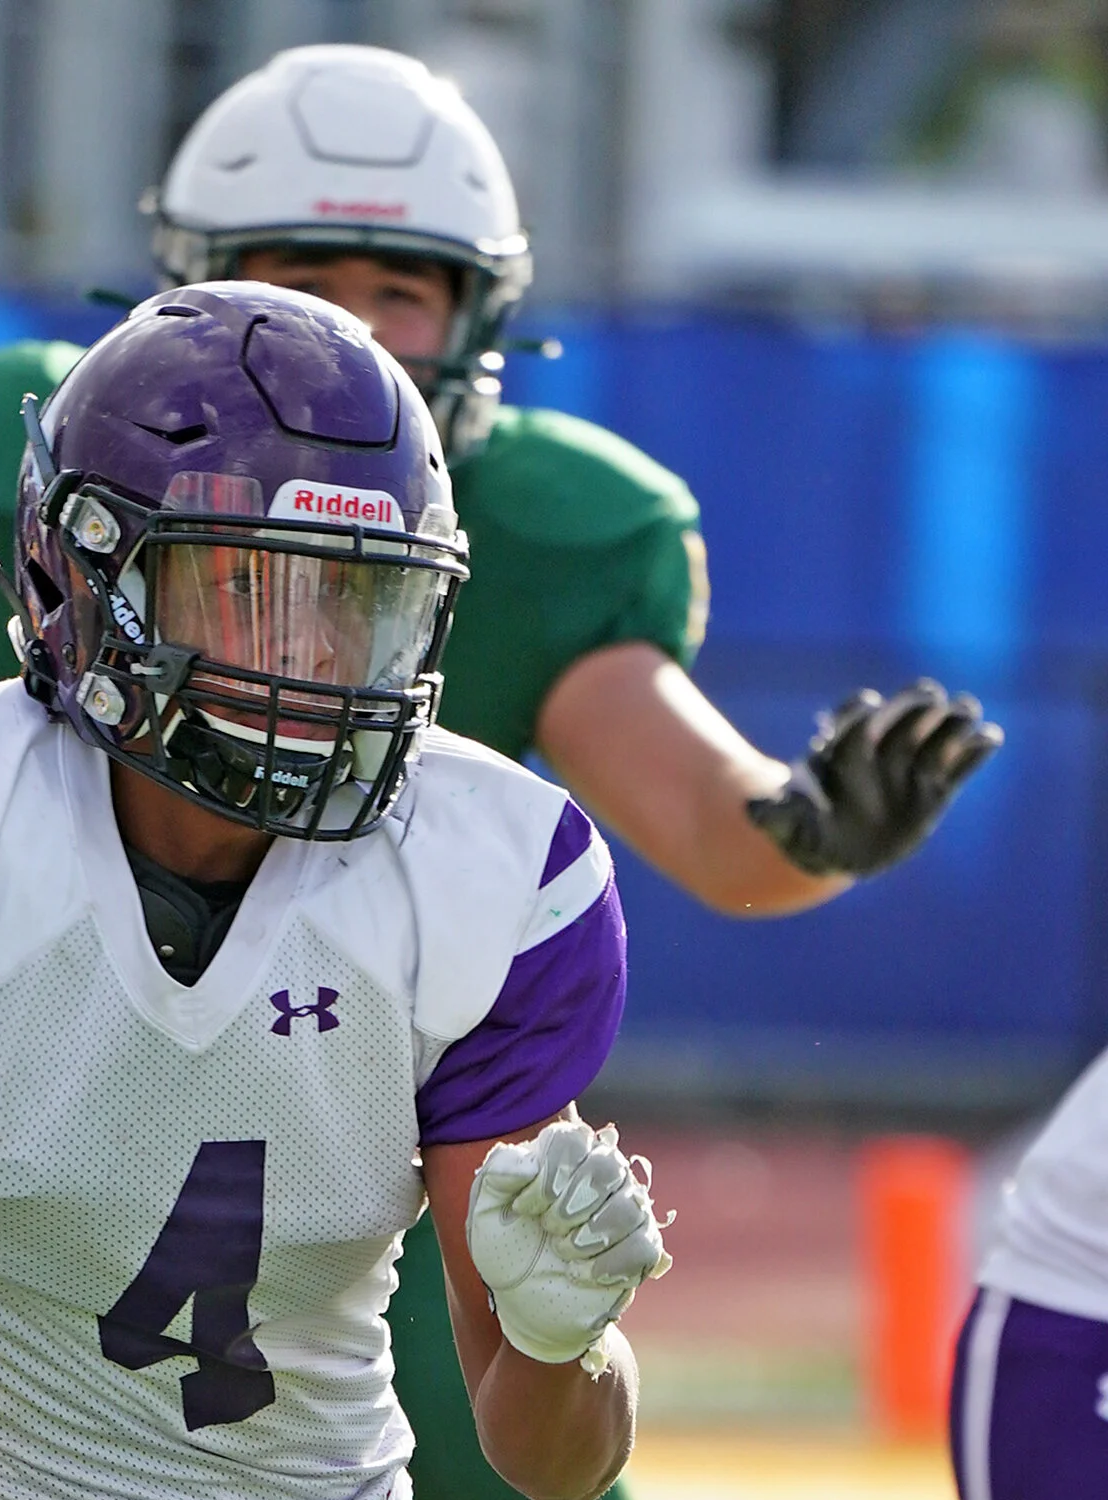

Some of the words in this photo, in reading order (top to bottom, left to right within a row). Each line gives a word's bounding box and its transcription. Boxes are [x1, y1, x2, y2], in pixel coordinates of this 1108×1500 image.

[293, 489, 392, 523] Riddell
[253, 766, 309, 789] Rddell
[96, 1139, 276, 1432] 4
